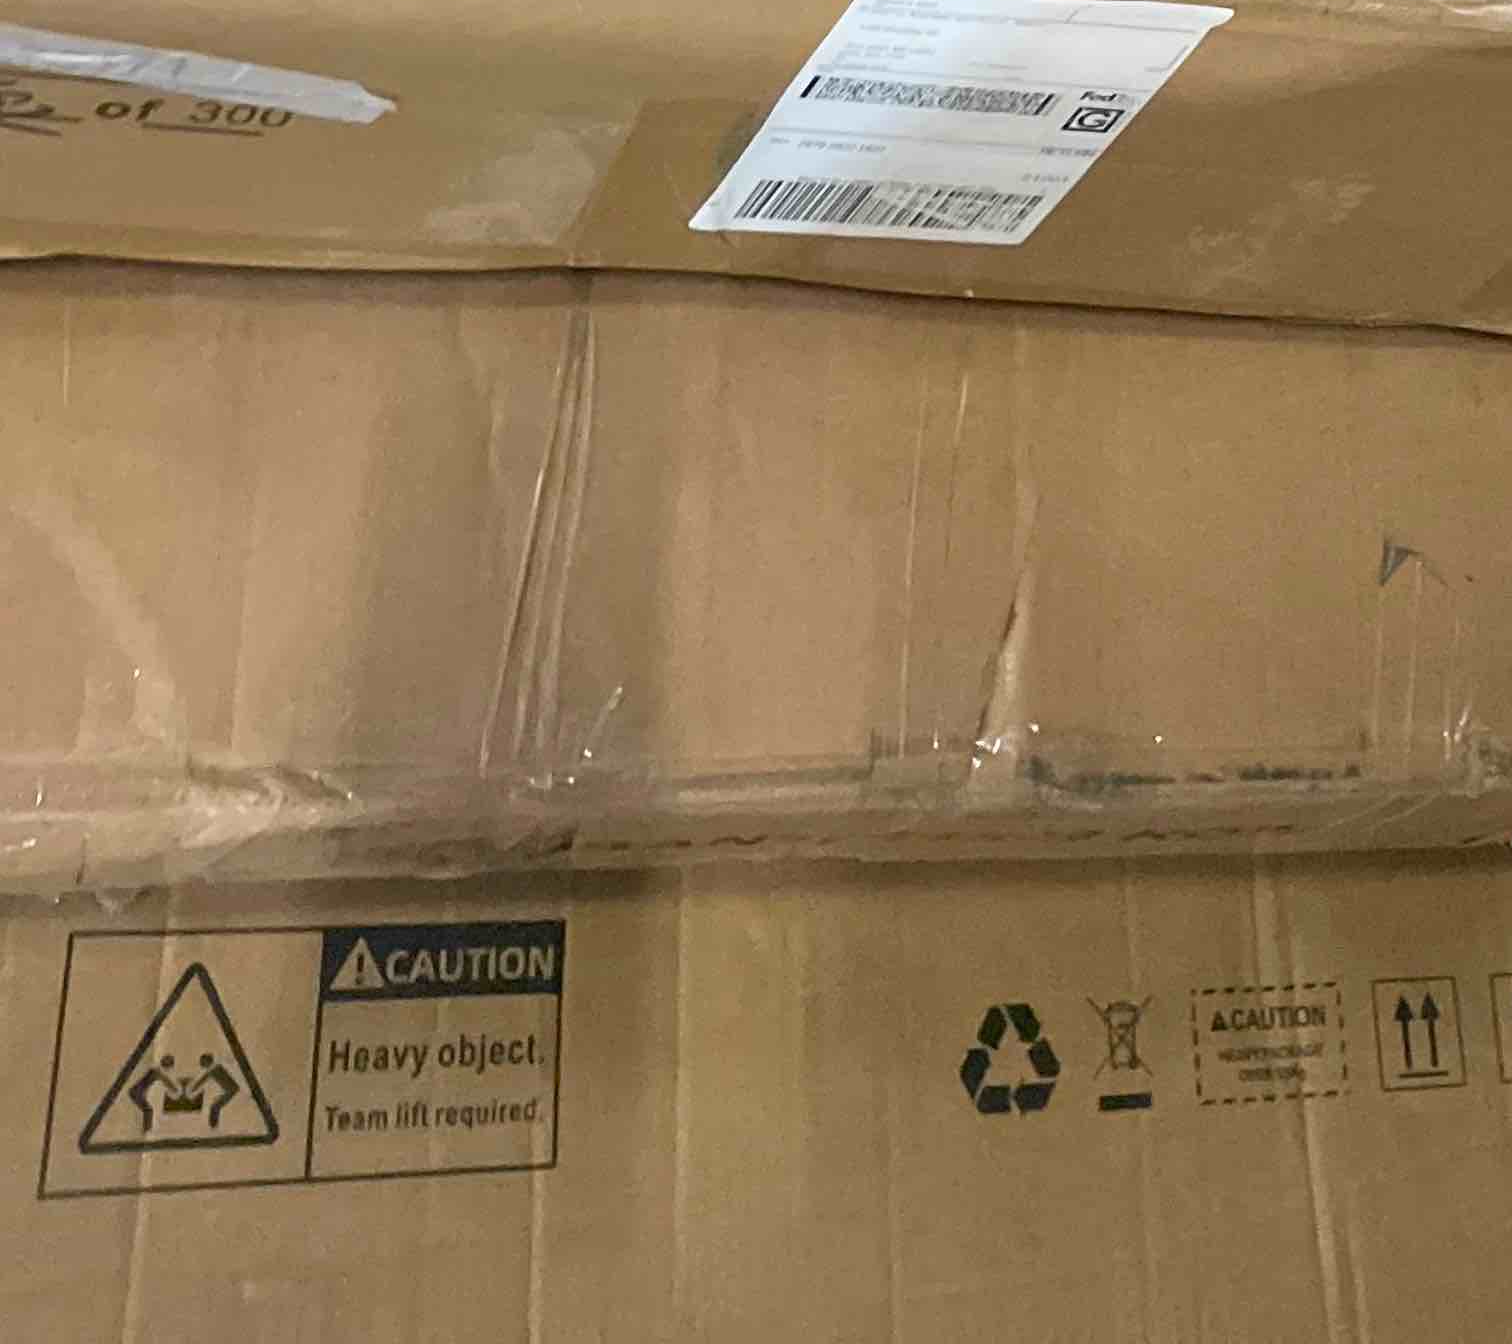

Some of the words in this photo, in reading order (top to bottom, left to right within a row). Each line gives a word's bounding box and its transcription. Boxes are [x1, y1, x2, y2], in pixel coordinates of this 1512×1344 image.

[384, 945, 556, 984] CAUTION
[1231, 1005, 1327, 1030] CAUTION
[326, 1036, 428, 1079] Heavy
[437, 1032, 547, 1069] object.
[324, 1105, 389, 1132] Team
[394, 1105, 432, 1129] lift
